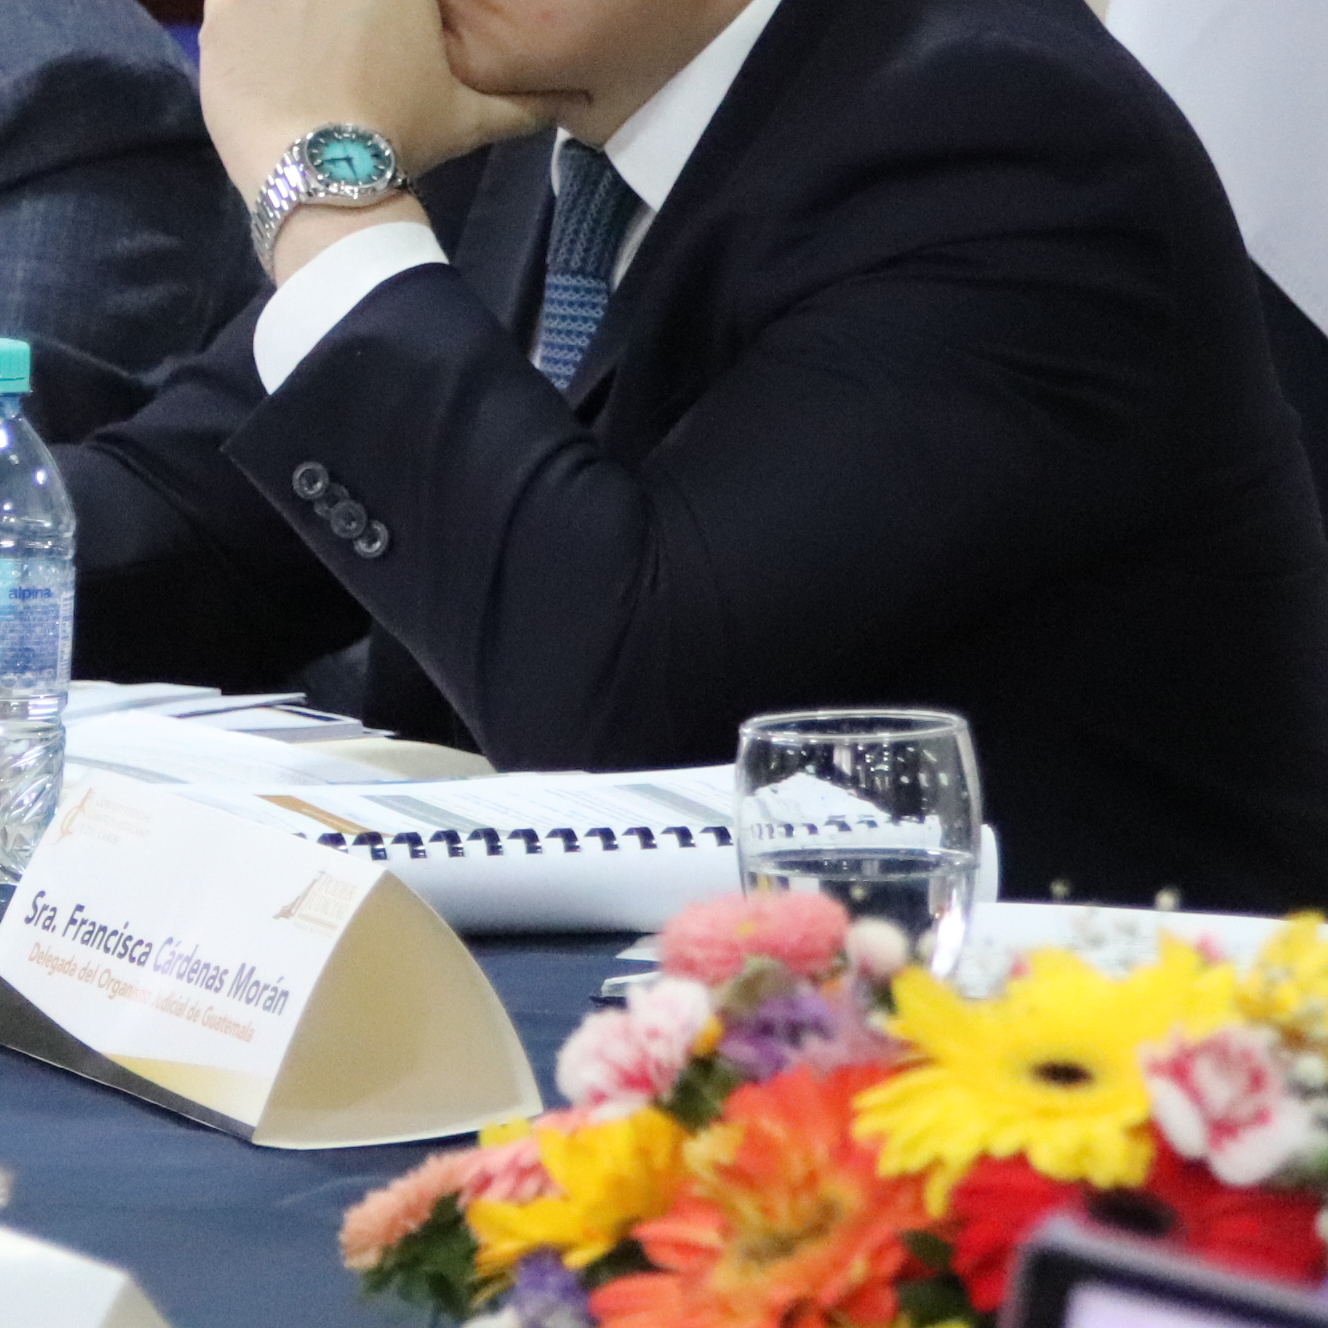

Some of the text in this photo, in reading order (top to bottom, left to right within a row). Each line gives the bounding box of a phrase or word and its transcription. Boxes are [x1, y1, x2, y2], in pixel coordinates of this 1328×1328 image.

[8, 586, 53, 602] alpina
[24, 890, 290, 1016] Sra. Francisca Cárdenas Morán
[28, 941, 78, 976] Delegada
[77, 959, 101, 984] del
[186, 999, 202, 1023] de
[201, 1005, 255, 1043] Guatemala
